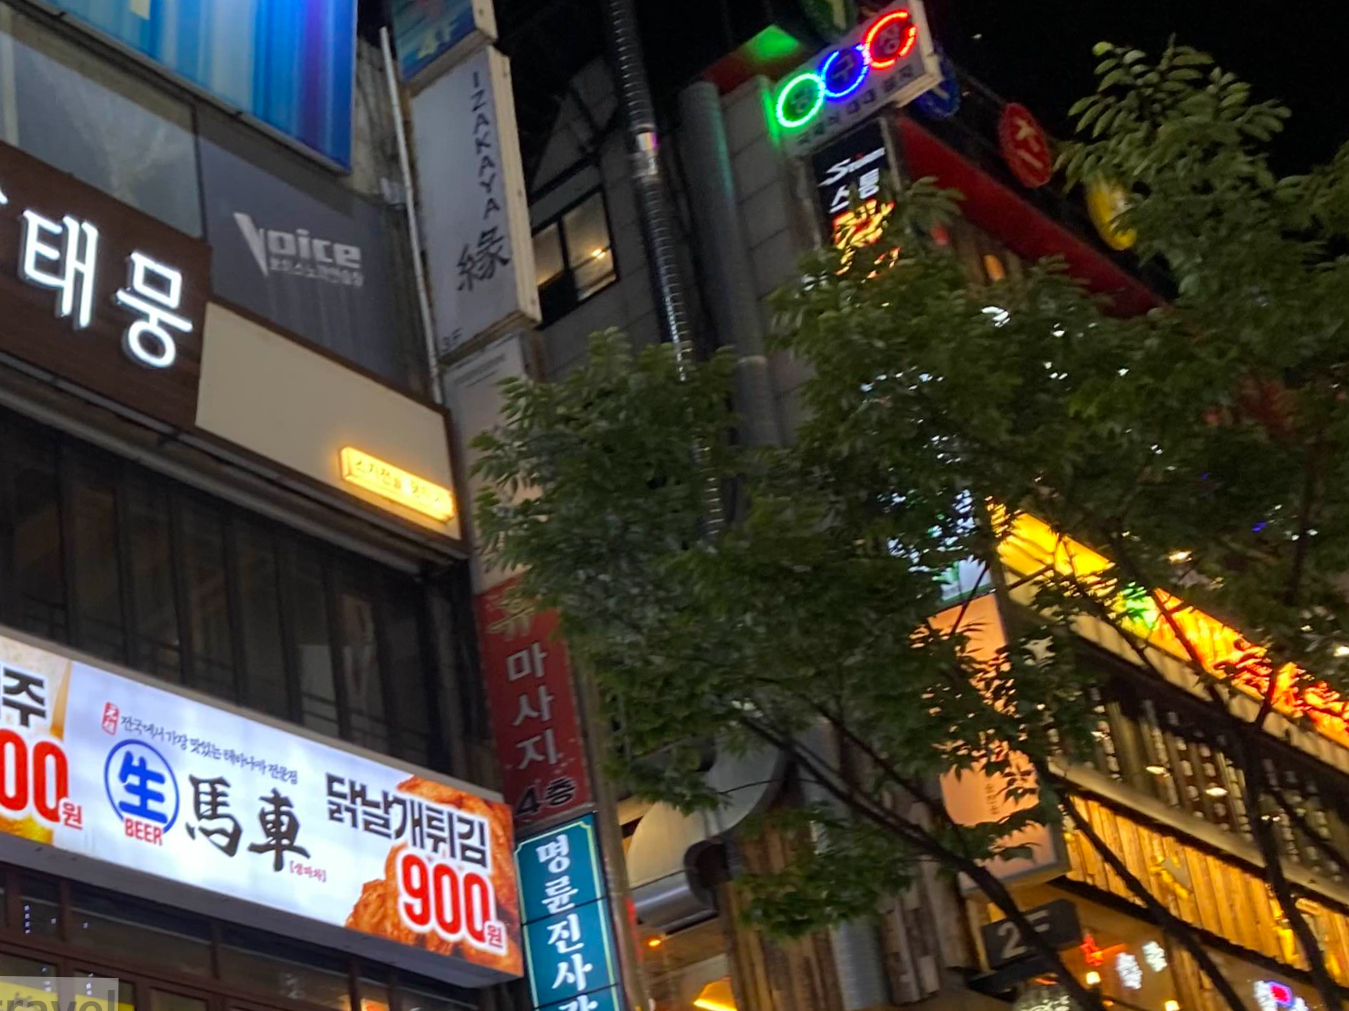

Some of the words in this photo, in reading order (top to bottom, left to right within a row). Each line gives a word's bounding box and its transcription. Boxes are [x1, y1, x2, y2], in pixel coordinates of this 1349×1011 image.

[472, 70, 501, 220] IZAKAYA
[233, 211, 361, 277] Voice
[120, 716, 165, 743] 전국에서
[166, 731, 188, 751] 가장
[506, 642, 559, 770] 마사지
[117, 749, 168, 826] 生
[185, 773, 311, 873] 馬車
[325, 771, 489, 869] 닭날개튀김
[124, 818, 164, 846] BEER
